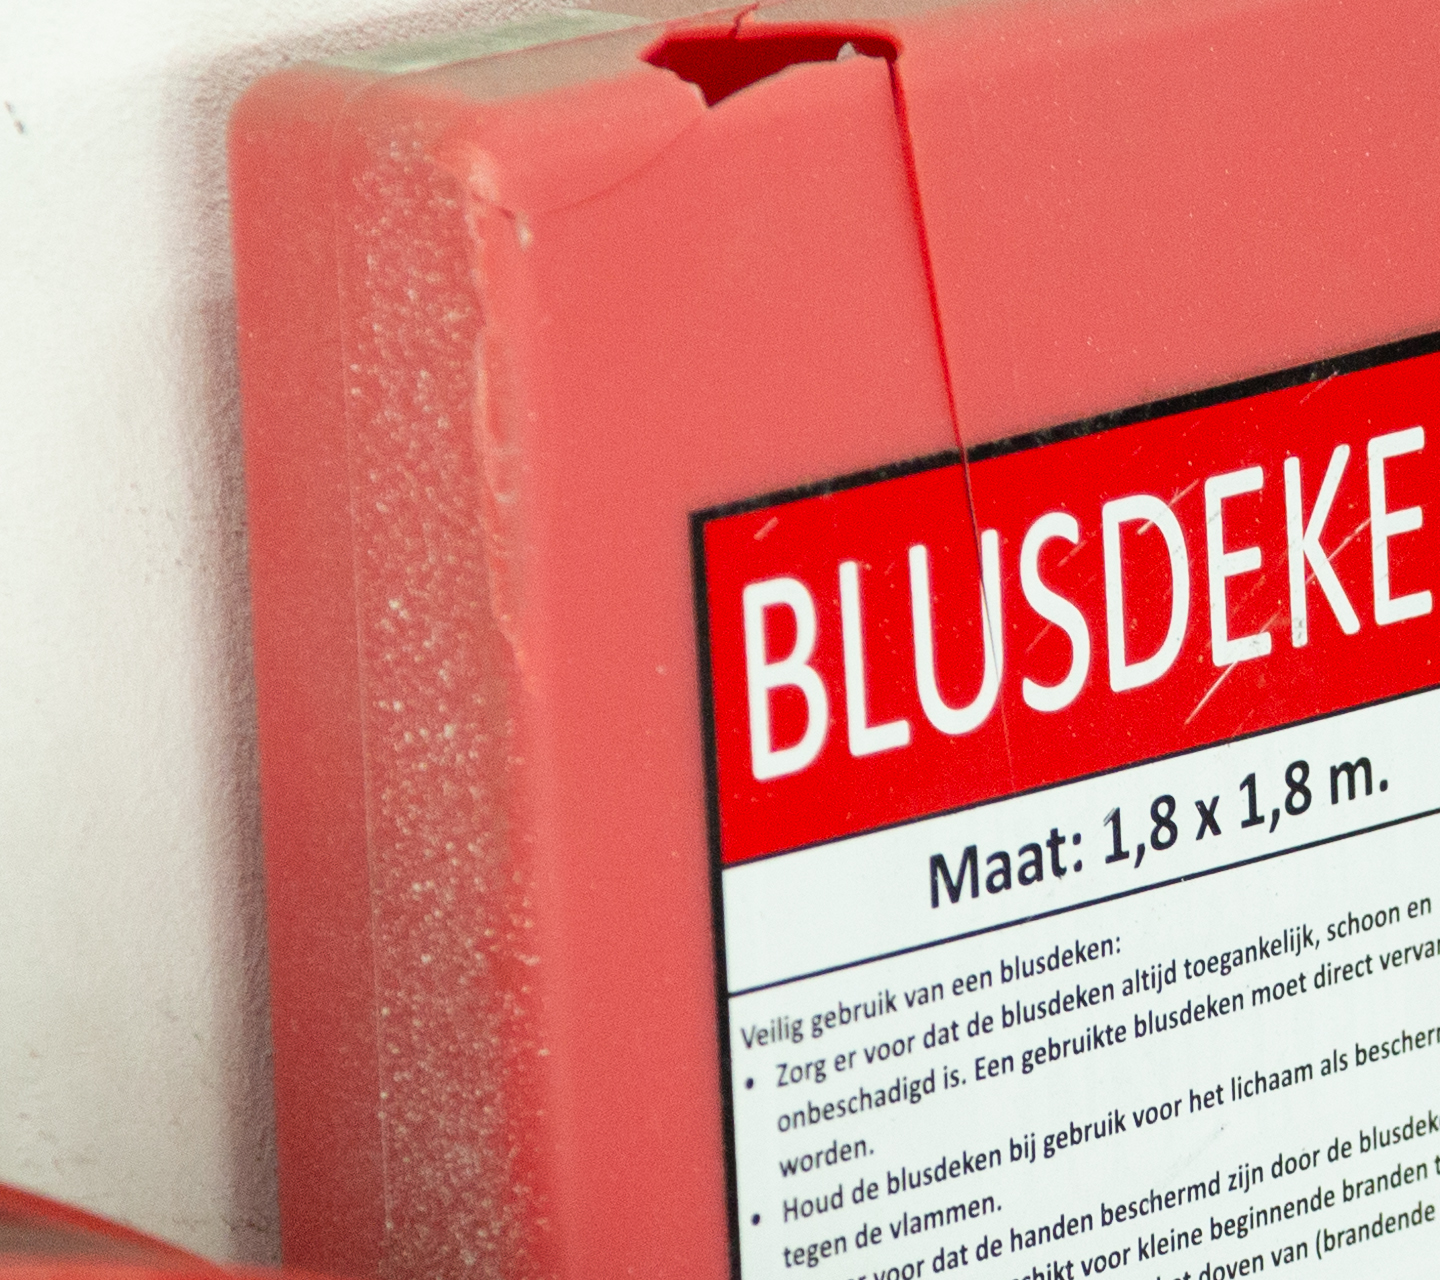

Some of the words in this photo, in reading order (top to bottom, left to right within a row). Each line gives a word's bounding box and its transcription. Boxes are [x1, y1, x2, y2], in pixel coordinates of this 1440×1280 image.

[928, 824, 1085, 910] Maat:
[1102, 792, 1179, 870] 1,8
[1193, 794, 1223, 842] x
[1238, 757, 1313, 834] 1,8
[1328, 755, 1390, 807] m.
[739, 1016, 805, 1050] Veilig
[810, 988, 898, 1040] gebruik
[903, 981, 945, 1009] van
[951, 969, 994, 997] een
[999, 935, 1122, 985] blusdeken:
[776, 1058, 828, 1088] Zorg
[833, 1049, 858, 1073] er
[862, 1034, 917, 1065] voor
[922, 1019, 961, 1050] dat
[966, 1010, 995, 1039] de
[1000, 981, 1116, 1030] blusdeken
[1121, 957, 1178, 998] altijd
[1182, 922, 1321, 981] toegankelijk,
[1325, 905, 1401, 943] schoon
[1406, 896, 1433, 920] en
[776, 1067, 936, 1134] onbeschadigd
[942, 1064, 968, 1091] is.
[973, 1054, 1015, 1083] Een
[1020, 1023, 1128, 1076] gebruikte
[1133, 992, 1245, 1039] blusdeken
[1250, 971, 1308, 1008] moet
[1312, 953, 1374, 991] direct
[778, 1138, 875, 1179] worden.
[782, 1183, 845, 1224] Houd
[851, 1177, 880, 1206] de
[886, 1147, 1003, 1197] blusdeken
[1008, 1131, 1037, 1165] bij
[1042, 1107, 1127, 1160] gebruik
[1131, 1097, 1184, 1129] voor
[1188, 1083, 1226, 1115] het
[1230, 1062, 1314, 1103] lichaam
[1319, 1048, 1350, 1078] als
[782, 1234, 848, 1270] tegen
[854, 1221, 883, 1250] de
[888, 1194, 1003, 1241] vlammen.
[931, 1243, 970, 1275] dat
[974, 1233, 1004, 1263] de
[1008, 1212, 1094, 1254] handen
[1099, 1169, 1222, 1228] beschermd
[1227, 1161, 1265, 1195] zijn
[1270, 1148, 1321, 1181] door
[1326, 1136, 1353, 1164] de
[1079, 1246, 1132, 1278] voor
[1137, 1226, 1204, 1263] kleine
[1209, 1185, 1336, 1242] beginnende
[1341, 1161, 1429, 1204] branden
[1269, 1240, 1309, 1268] van
[1314, 1199, 1436, 1261] (brandende
